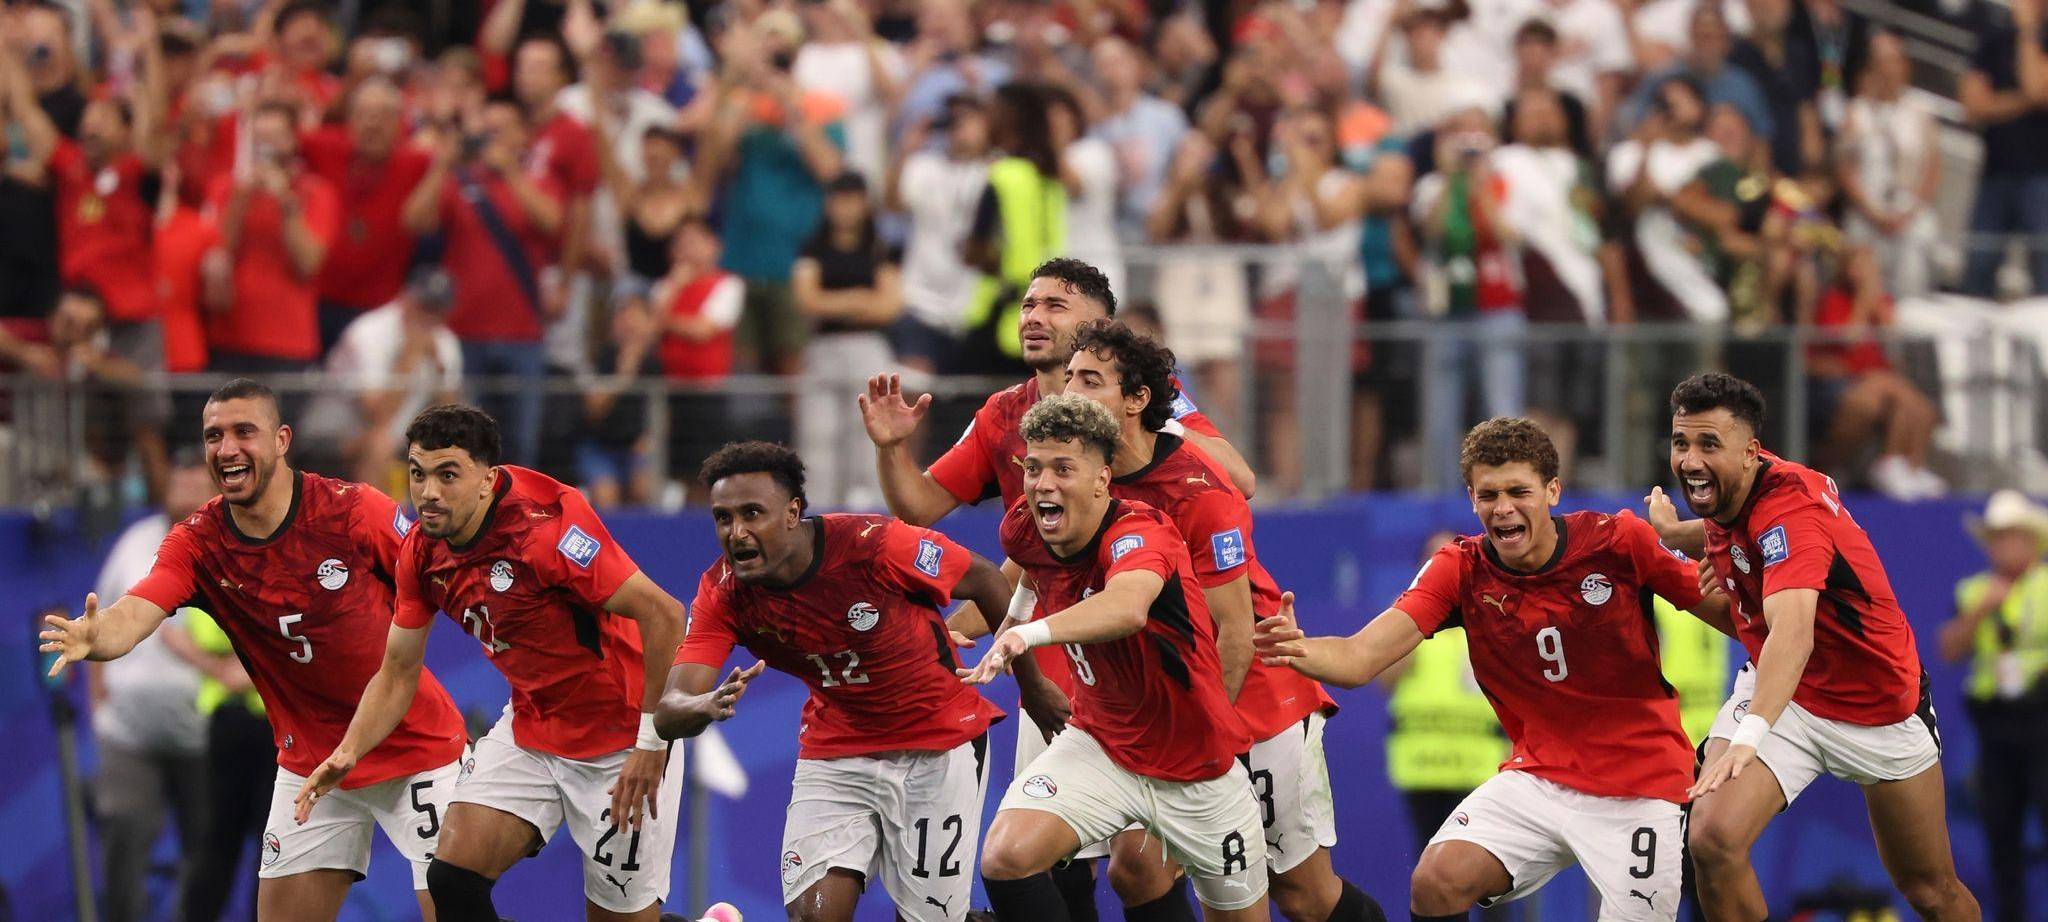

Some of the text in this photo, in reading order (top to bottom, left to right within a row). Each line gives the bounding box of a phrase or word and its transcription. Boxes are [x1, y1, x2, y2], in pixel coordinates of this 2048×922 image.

[278, 613, 313, 664] 5
[1065, 643, 1096, 687] 8
[1536, 626, 1568, 683] 9
[805, 649, 870, 688] 12
[411, 780, 440, 839] 5
[592, 808, 643, 872] 21
[911, 814, 962, 879] 12
[1221, 830, 1248, 876] 8
[1629, 826, 1657, 879] 9
